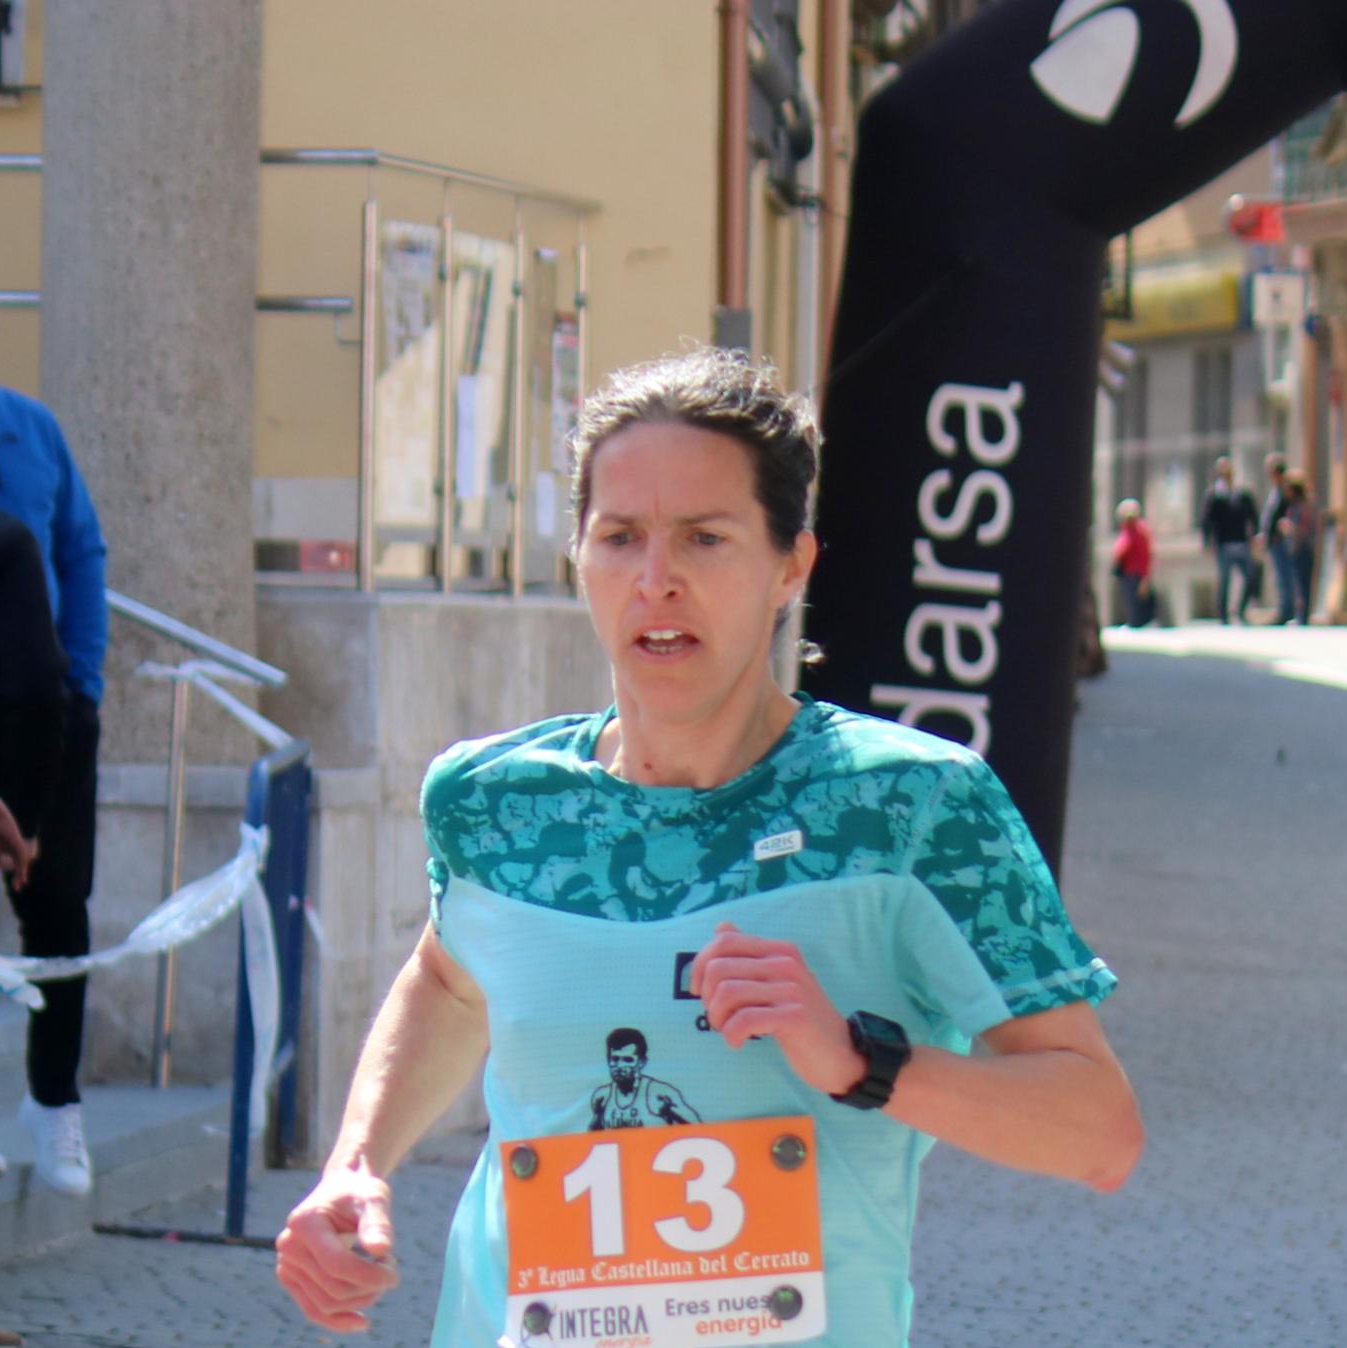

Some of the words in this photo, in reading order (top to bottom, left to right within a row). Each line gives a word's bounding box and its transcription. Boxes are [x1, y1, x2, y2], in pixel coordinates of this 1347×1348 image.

[562, 1136, 746, 1258] 13
[538, 1265, 586, 1289] Legua
[591, 1259, 693, 1281] Castellana
[699, 1256, 728, 1274] del
[733, 1250, 811, 1272] Cerrato
[559, 1305, 650, 1340] INTEGRA
[665, 1297, 710, 1317] Eres
